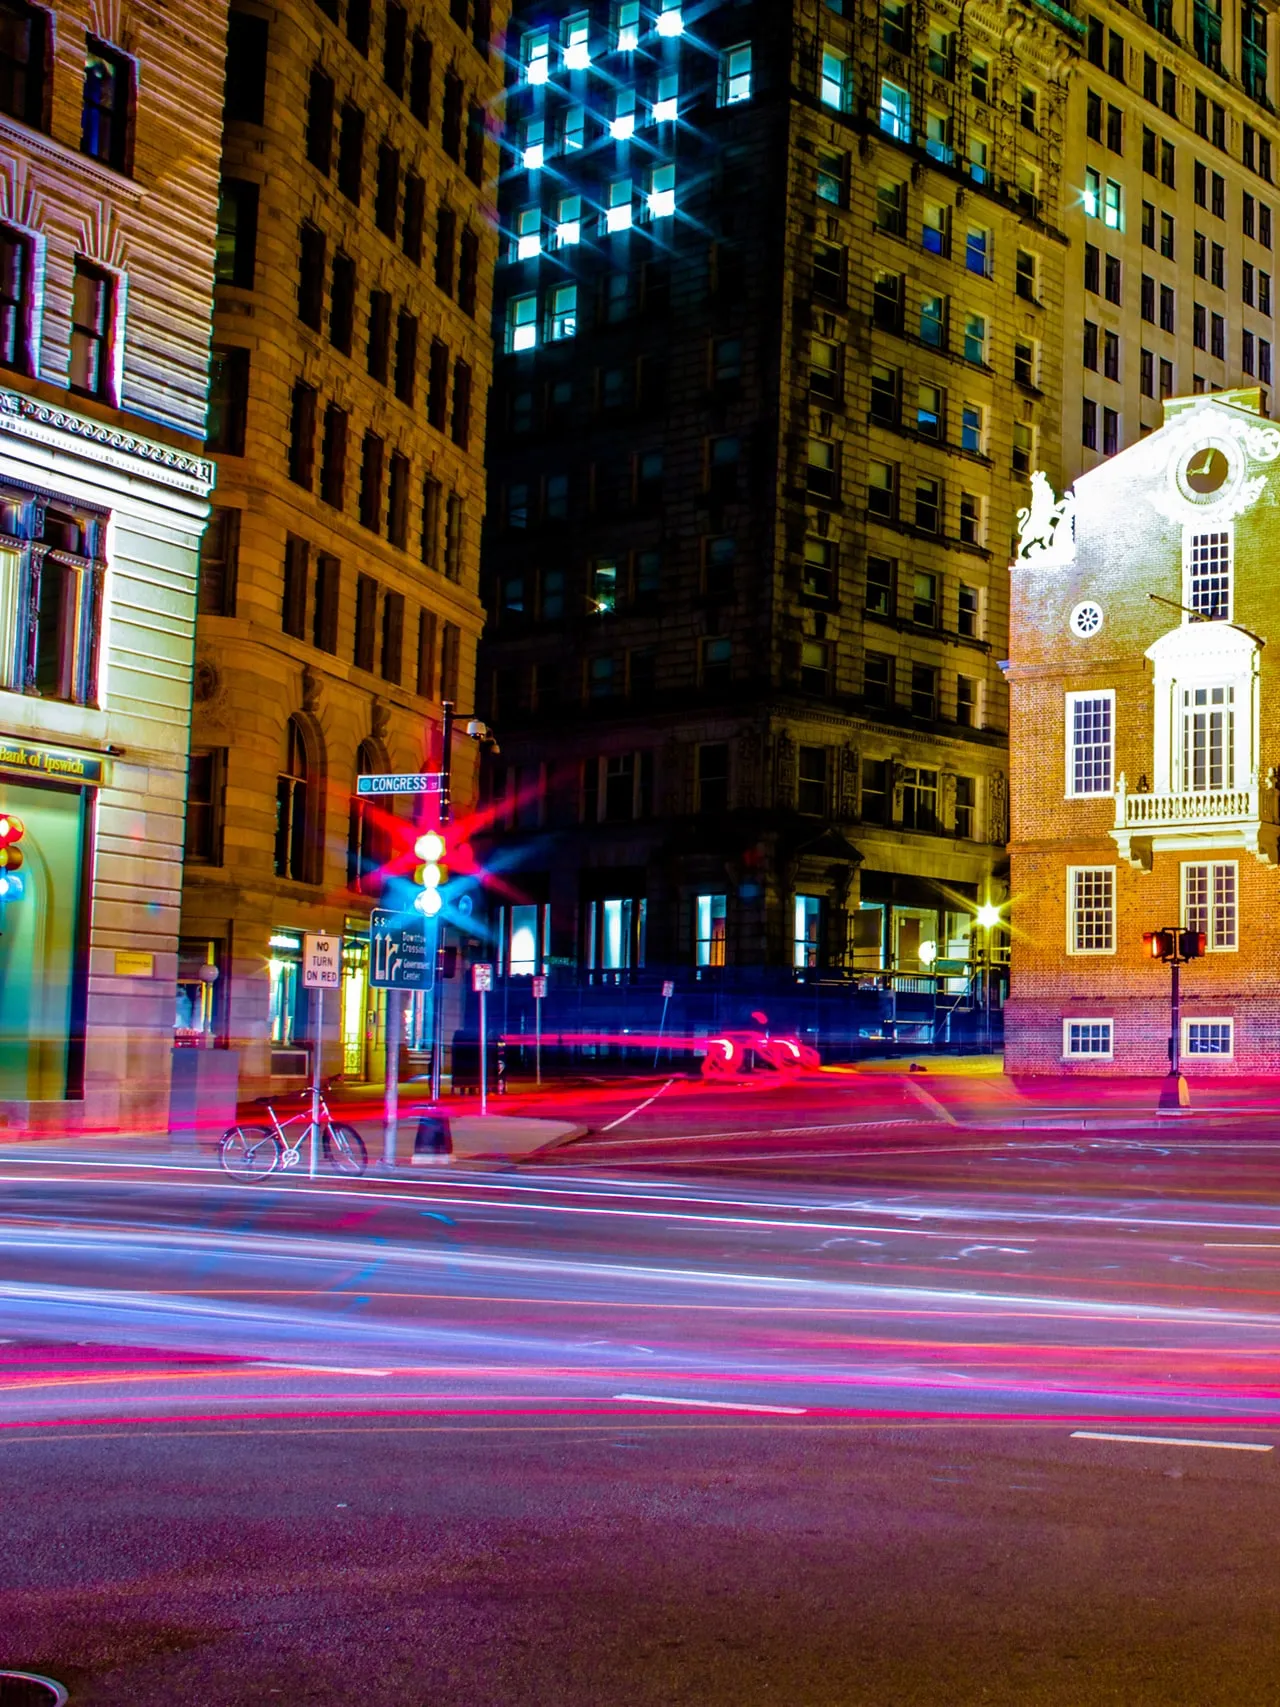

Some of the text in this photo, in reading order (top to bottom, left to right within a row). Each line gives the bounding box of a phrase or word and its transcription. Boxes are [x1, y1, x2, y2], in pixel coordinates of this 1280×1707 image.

[0, 746, 84, 774] Bank of Ipswich
[372, 777, 427, 791] CONGRESS
[316, 941, 329, 952] NO
[312, 955, 334, 967] TURN
[306, 970, 337, 982] ON RED
